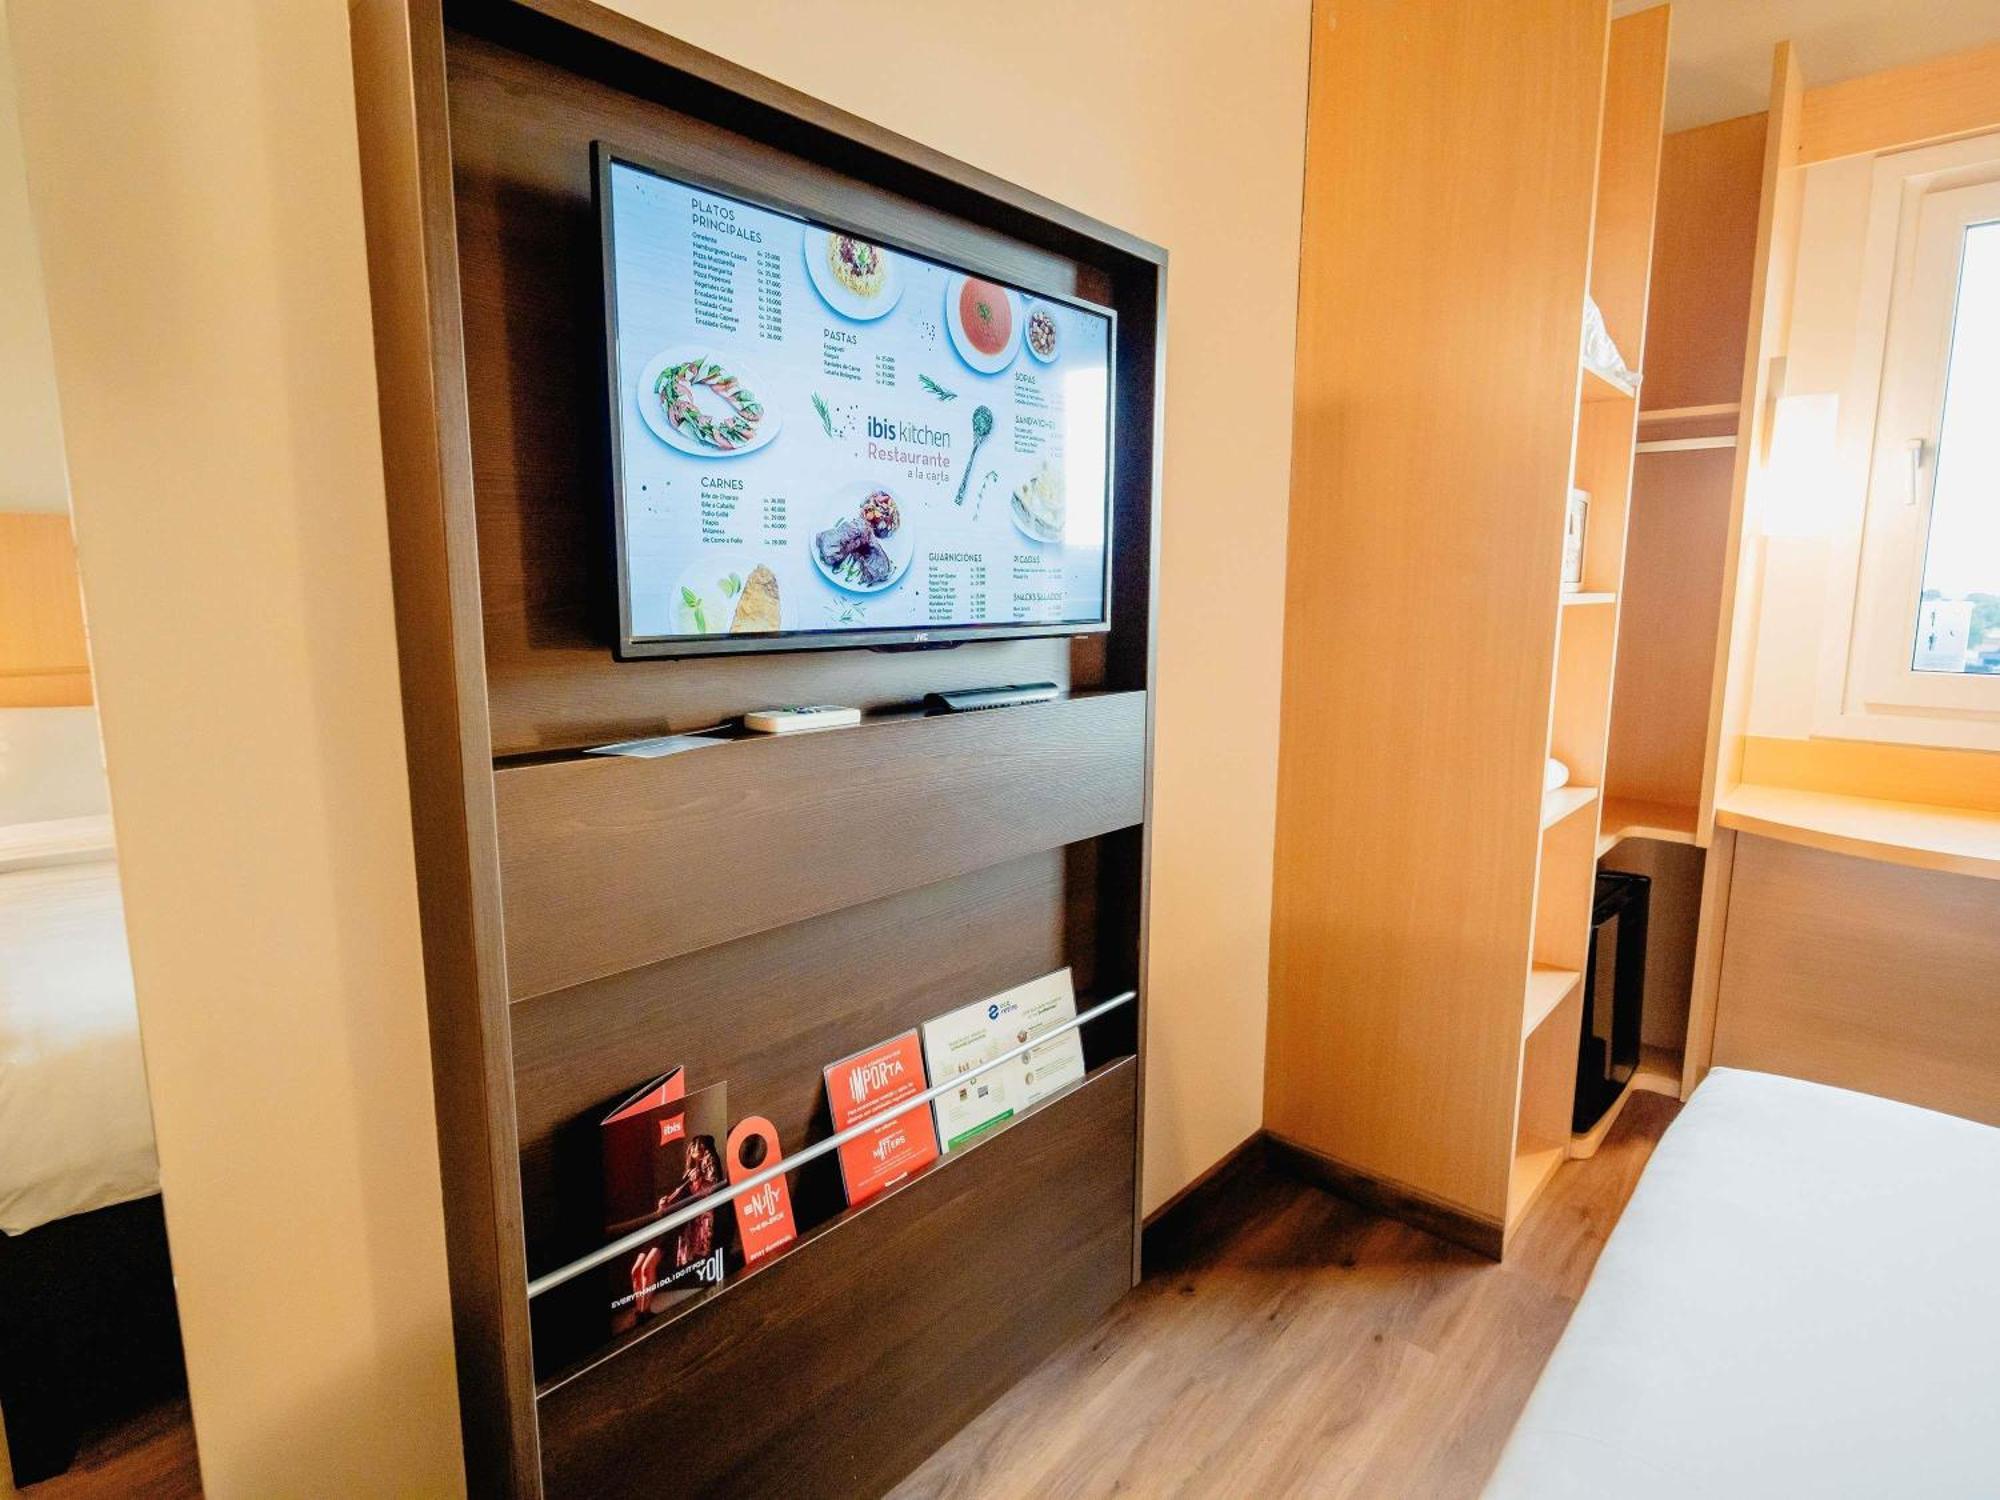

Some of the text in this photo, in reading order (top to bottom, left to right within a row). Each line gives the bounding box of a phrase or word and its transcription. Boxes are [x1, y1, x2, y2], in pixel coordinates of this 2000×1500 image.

[691, 198, 736, 221] PLATOS
[692, 213, 762, 244] PRINCIPALES
[823, 328, 857, 345] PASTAS
[867, 415, 951, 448] ibis kitchen
[868, 442, 950, 468] Restaurante
[700, 476, 744, 490] CARNES
[907, 466, 949, 482] a la carta
[928, 552, 983, 563] GUARNICIONES
[848, 1060, 905, 1104] IMPORTA
[662, 1120, 682, 1137] ibis
[696, 1247, 724, 1282] YOU
[611, 1283, 657, 1309] EVERYTHING
